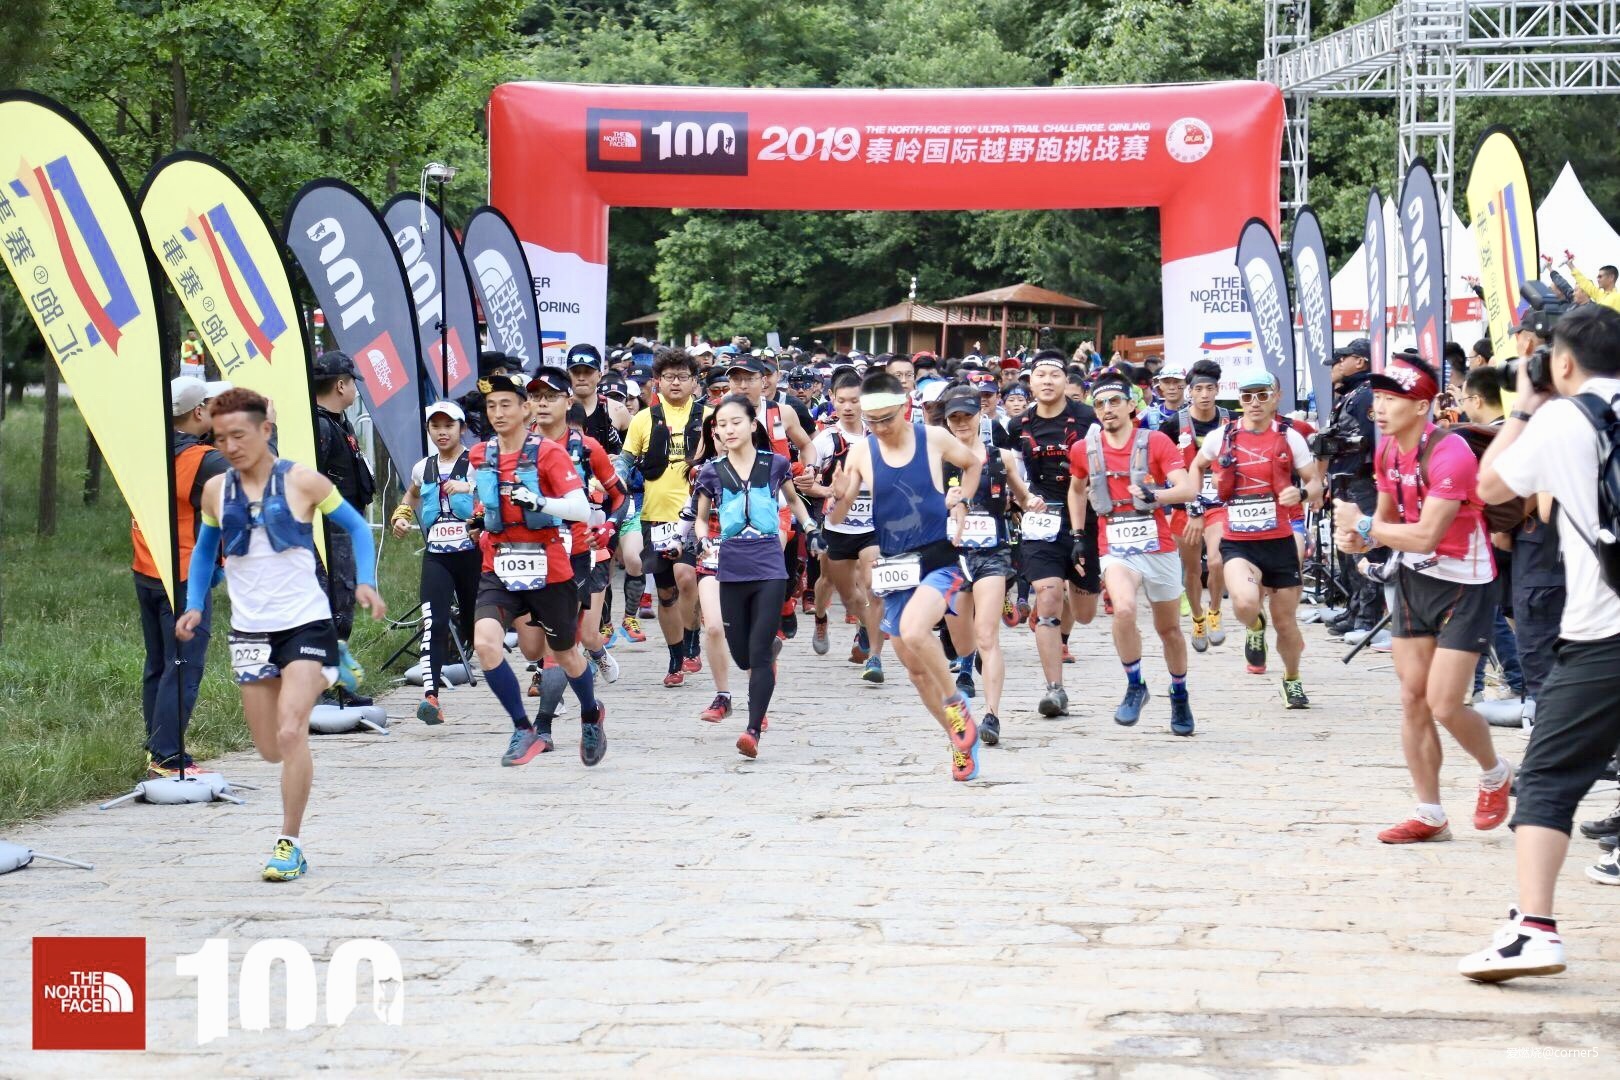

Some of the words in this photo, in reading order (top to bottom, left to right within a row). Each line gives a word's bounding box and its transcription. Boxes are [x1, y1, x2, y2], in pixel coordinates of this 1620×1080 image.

[865, 126, 886, 135] THE
[887, 126, 922, 135] NORTH
[924, 126, 951, 134] FACE
[977, 124, 1010, 133] ULTRA
[1012, 124, 1039, 133] TRAIL
[1108, 122, 1151, 132] QINLING
[652, 121, 736, 160] 100
[757, 125, 861, 161] 2019
[865, 135, 1150, 165] 秦岭国际越野跑挑战赛
[1212, 277, 1239, 289] THE
[1190, 289, 1240, 302] NORTH
[1203, 301, 1239, 313] FACE
[851, 503, 870, 512] 021
[1237, 507, 1267, 517] 1024
[964, 520, 987, 530] 012
[436, 526, 463, 537] 1065
[1116, 526, 1147, 538] 1022
[501, 560, 534, 571] 1031
[879, 570, 909, 582] 1006
